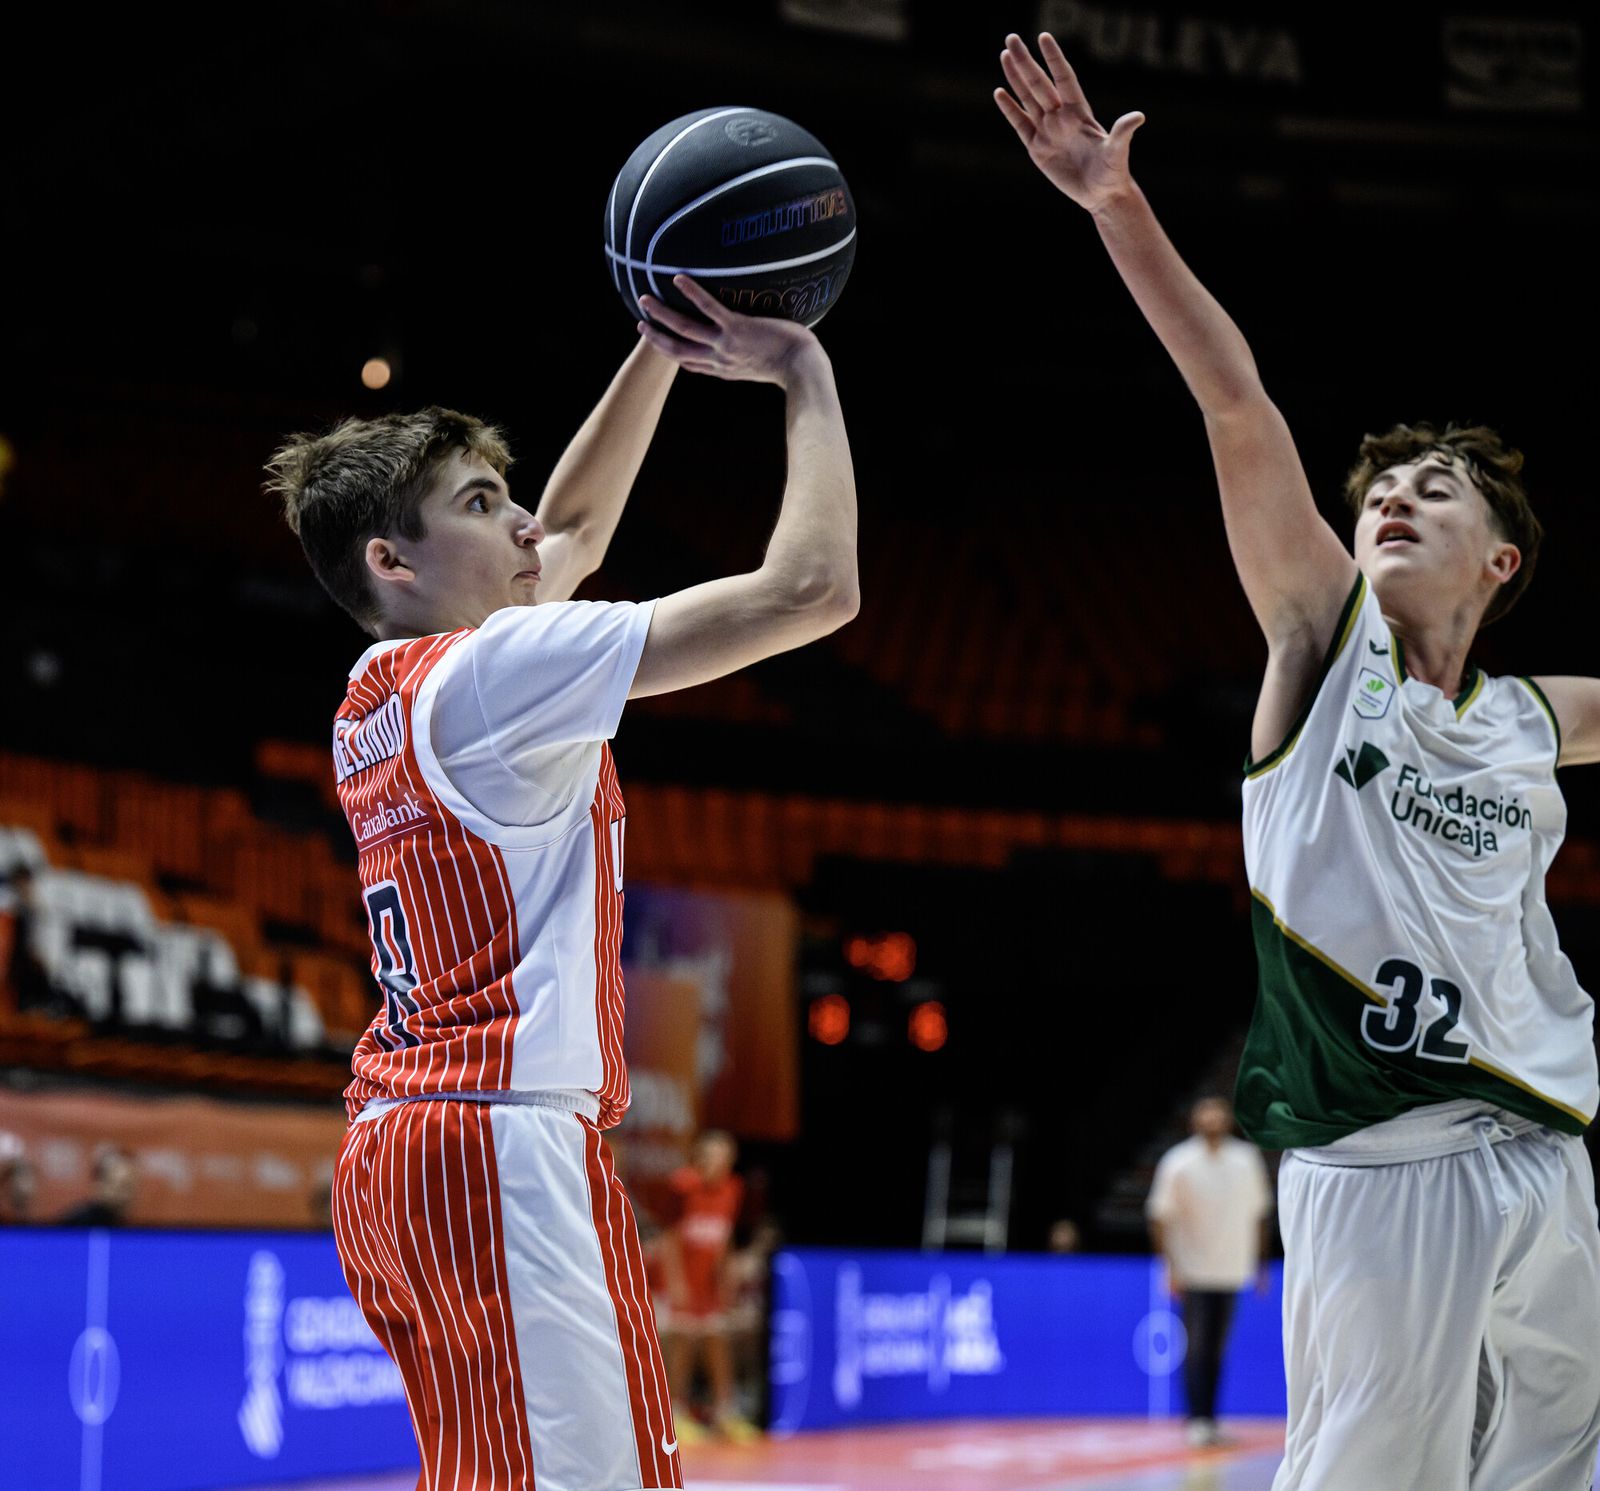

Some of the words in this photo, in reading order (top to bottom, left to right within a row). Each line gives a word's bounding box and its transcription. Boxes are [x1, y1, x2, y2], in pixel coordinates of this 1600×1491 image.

[352, 791, 428, 843] CaixaBank
[1390, 790, 1499, 857] Unicaja
[1360, 953, 1472, 1065] 32
